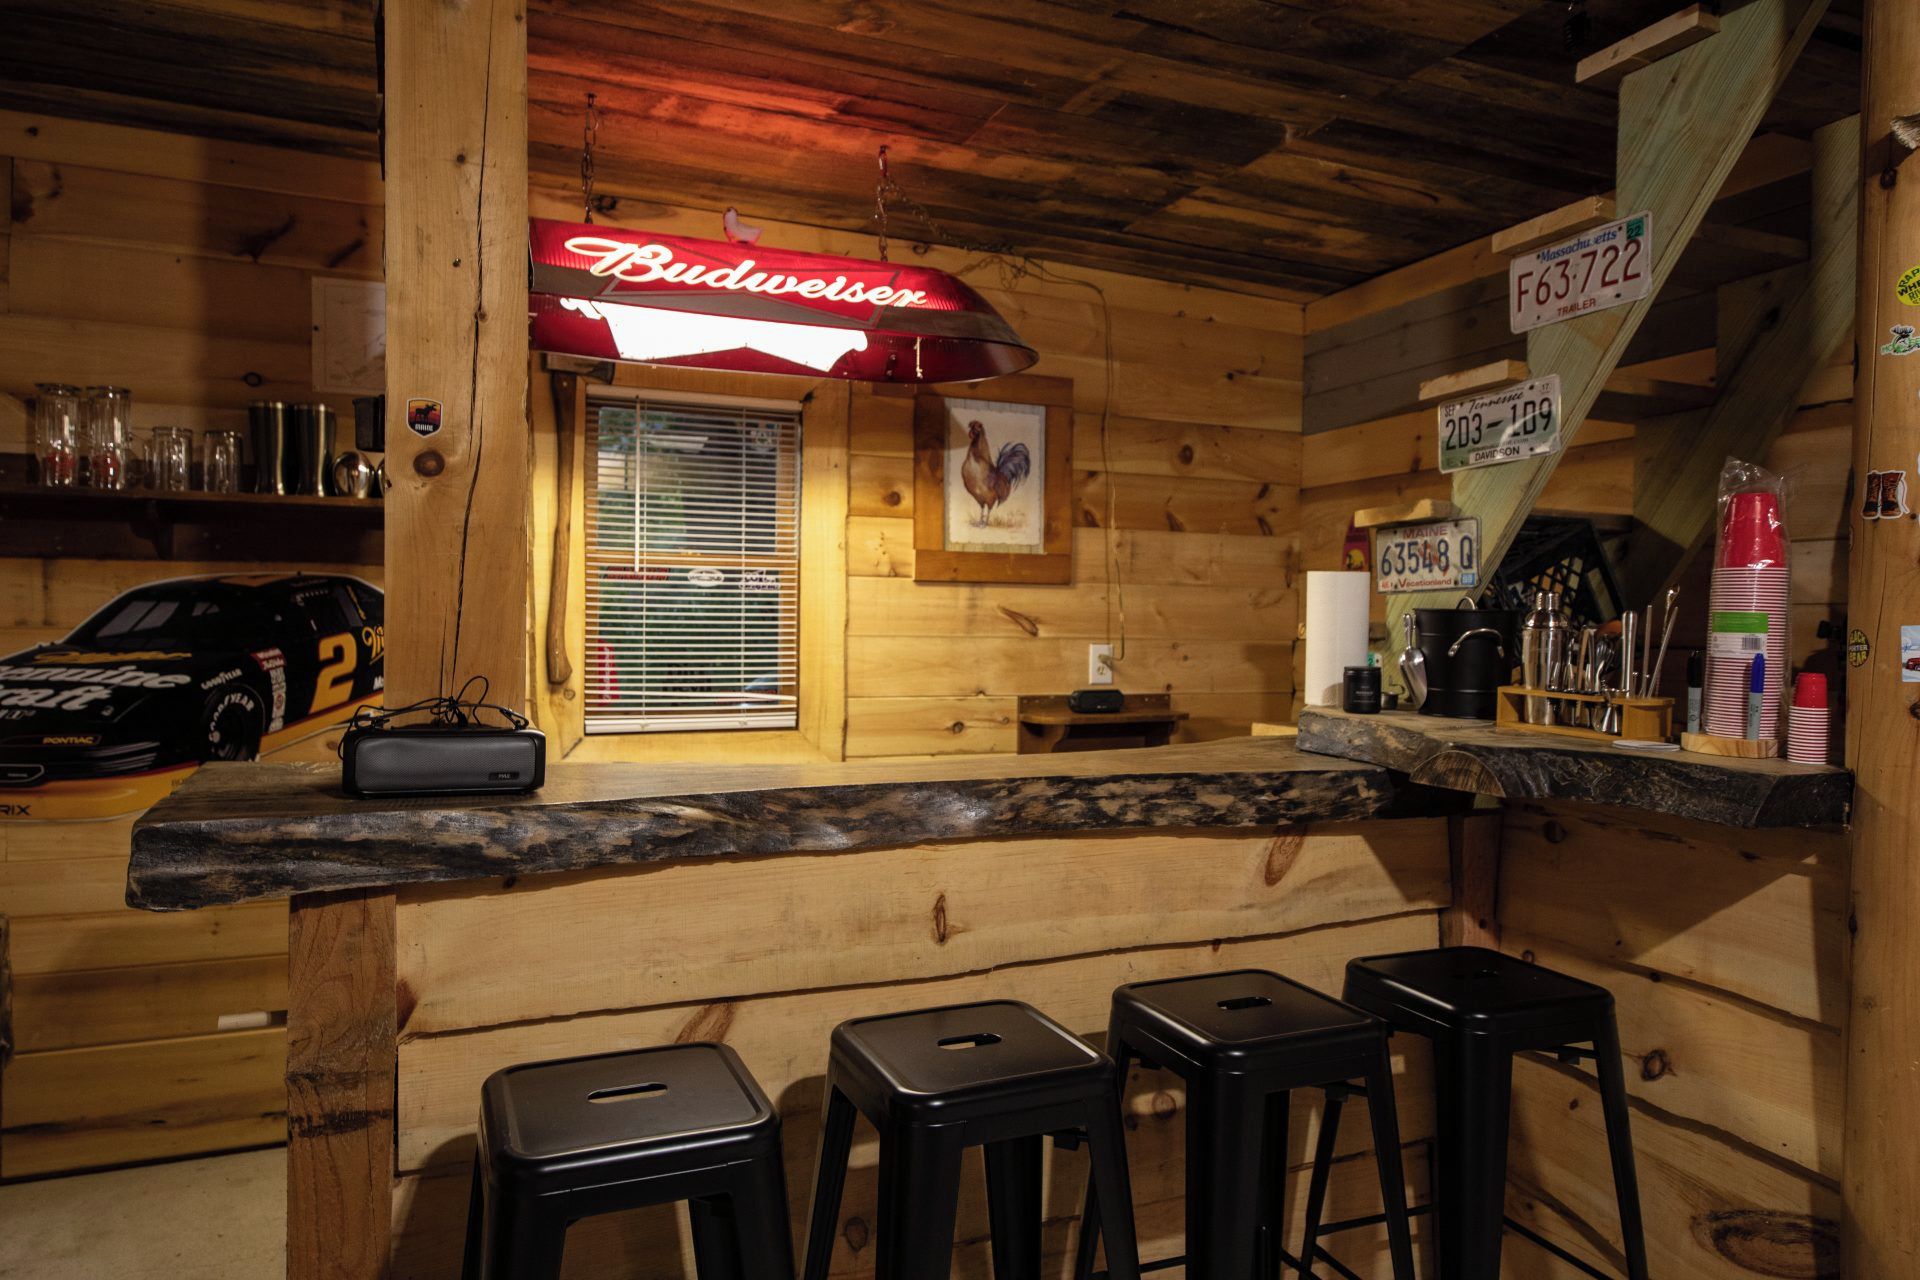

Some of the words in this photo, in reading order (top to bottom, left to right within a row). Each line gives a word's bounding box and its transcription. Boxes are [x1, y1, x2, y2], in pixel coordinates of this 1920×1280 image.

[1627, 226, 1642, 239] 22
[564, 236, 927, 308] Budweiser
[1557, 298, 1597, 317] TRAILER
[1468, 391, 1525, 414] Tennessee
[1474, 446, 1520, 462] DAVIDSON
[1402, 525, 1449, 539] MAINE
[1381, 538, 1450, 577] 63548
[1398, 577, 1452, 589] Vacationland
[308, 631, 358, 717] 2
[43, 736, 95, 745] PONTIAC
